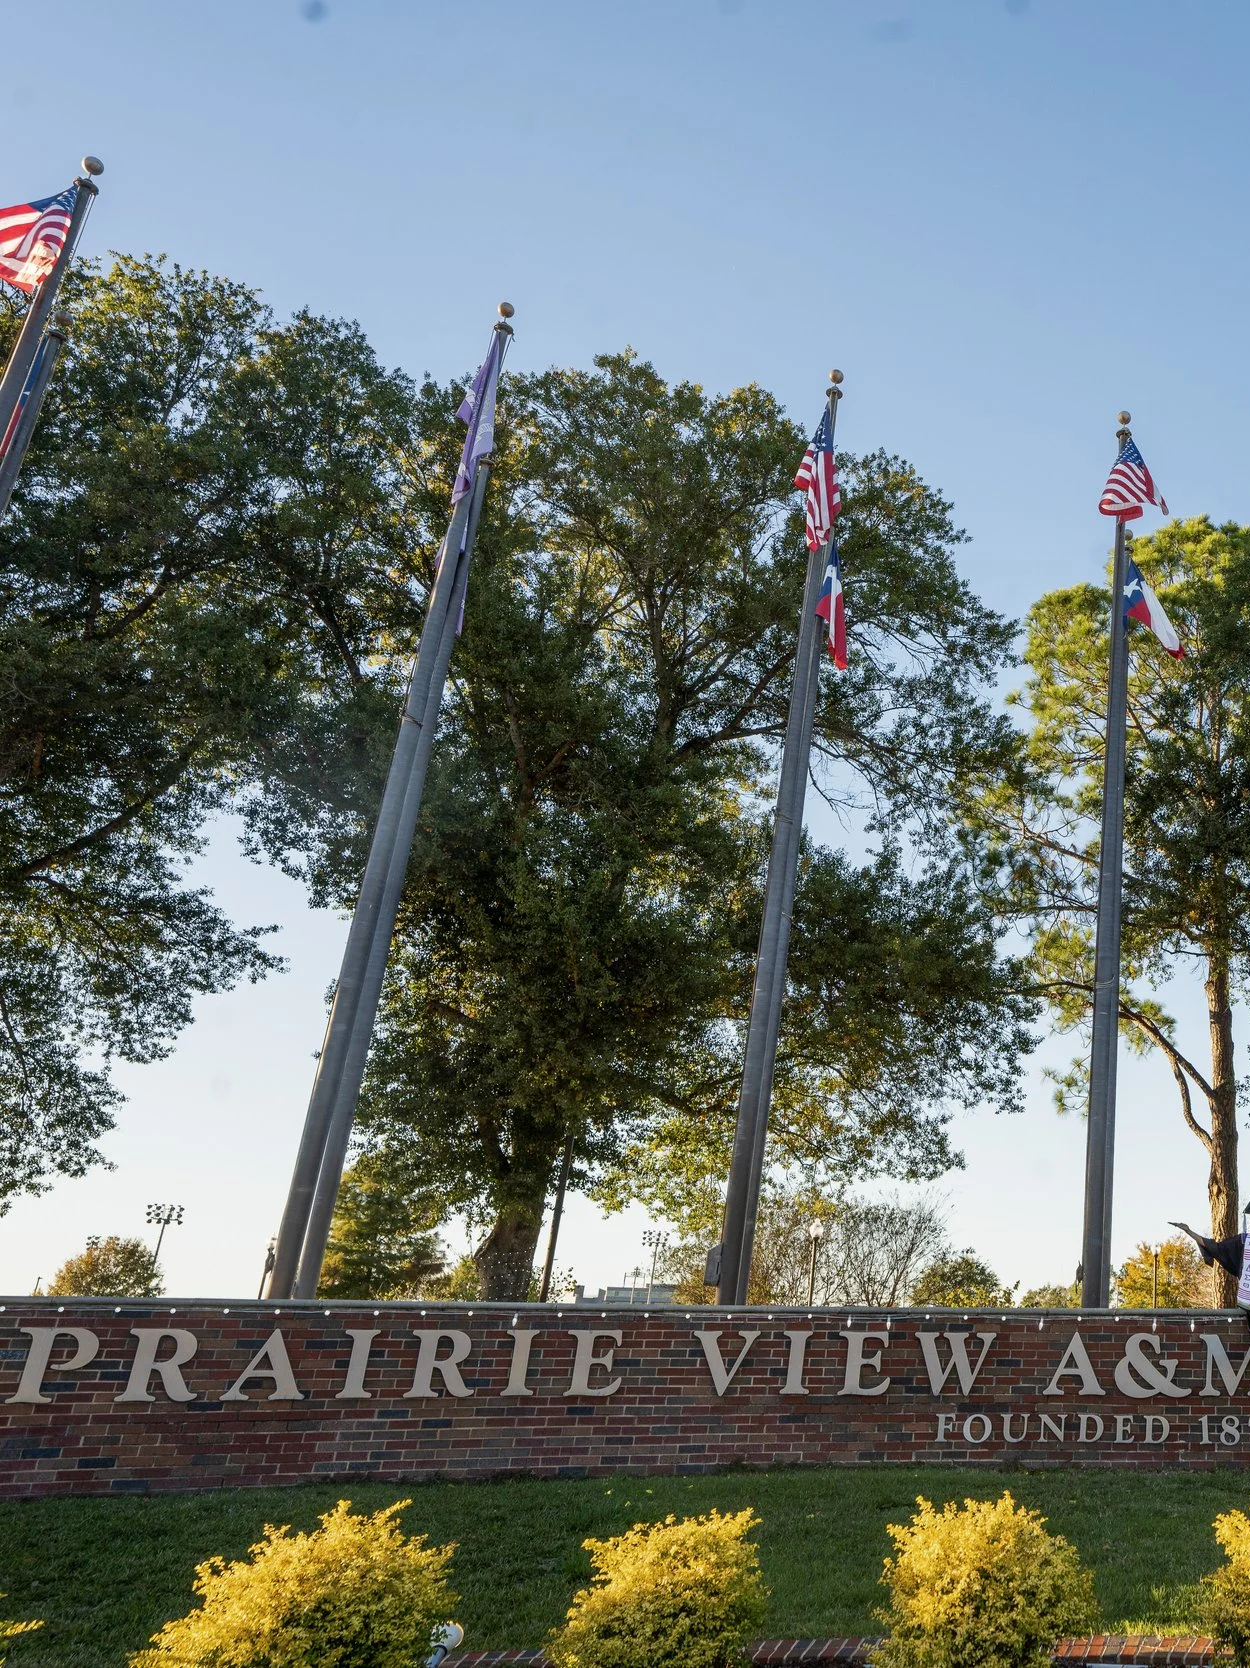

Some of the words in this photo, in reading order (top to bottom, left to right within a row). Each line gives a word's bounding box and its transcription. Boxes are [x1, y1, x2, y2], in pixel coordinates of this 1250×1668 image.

[4, 1327, 624, 1404] PRAIRIE
[693, 1330, 998, 1397] VIEW
[935, 1412, 1170, 1445] FOUNDED
